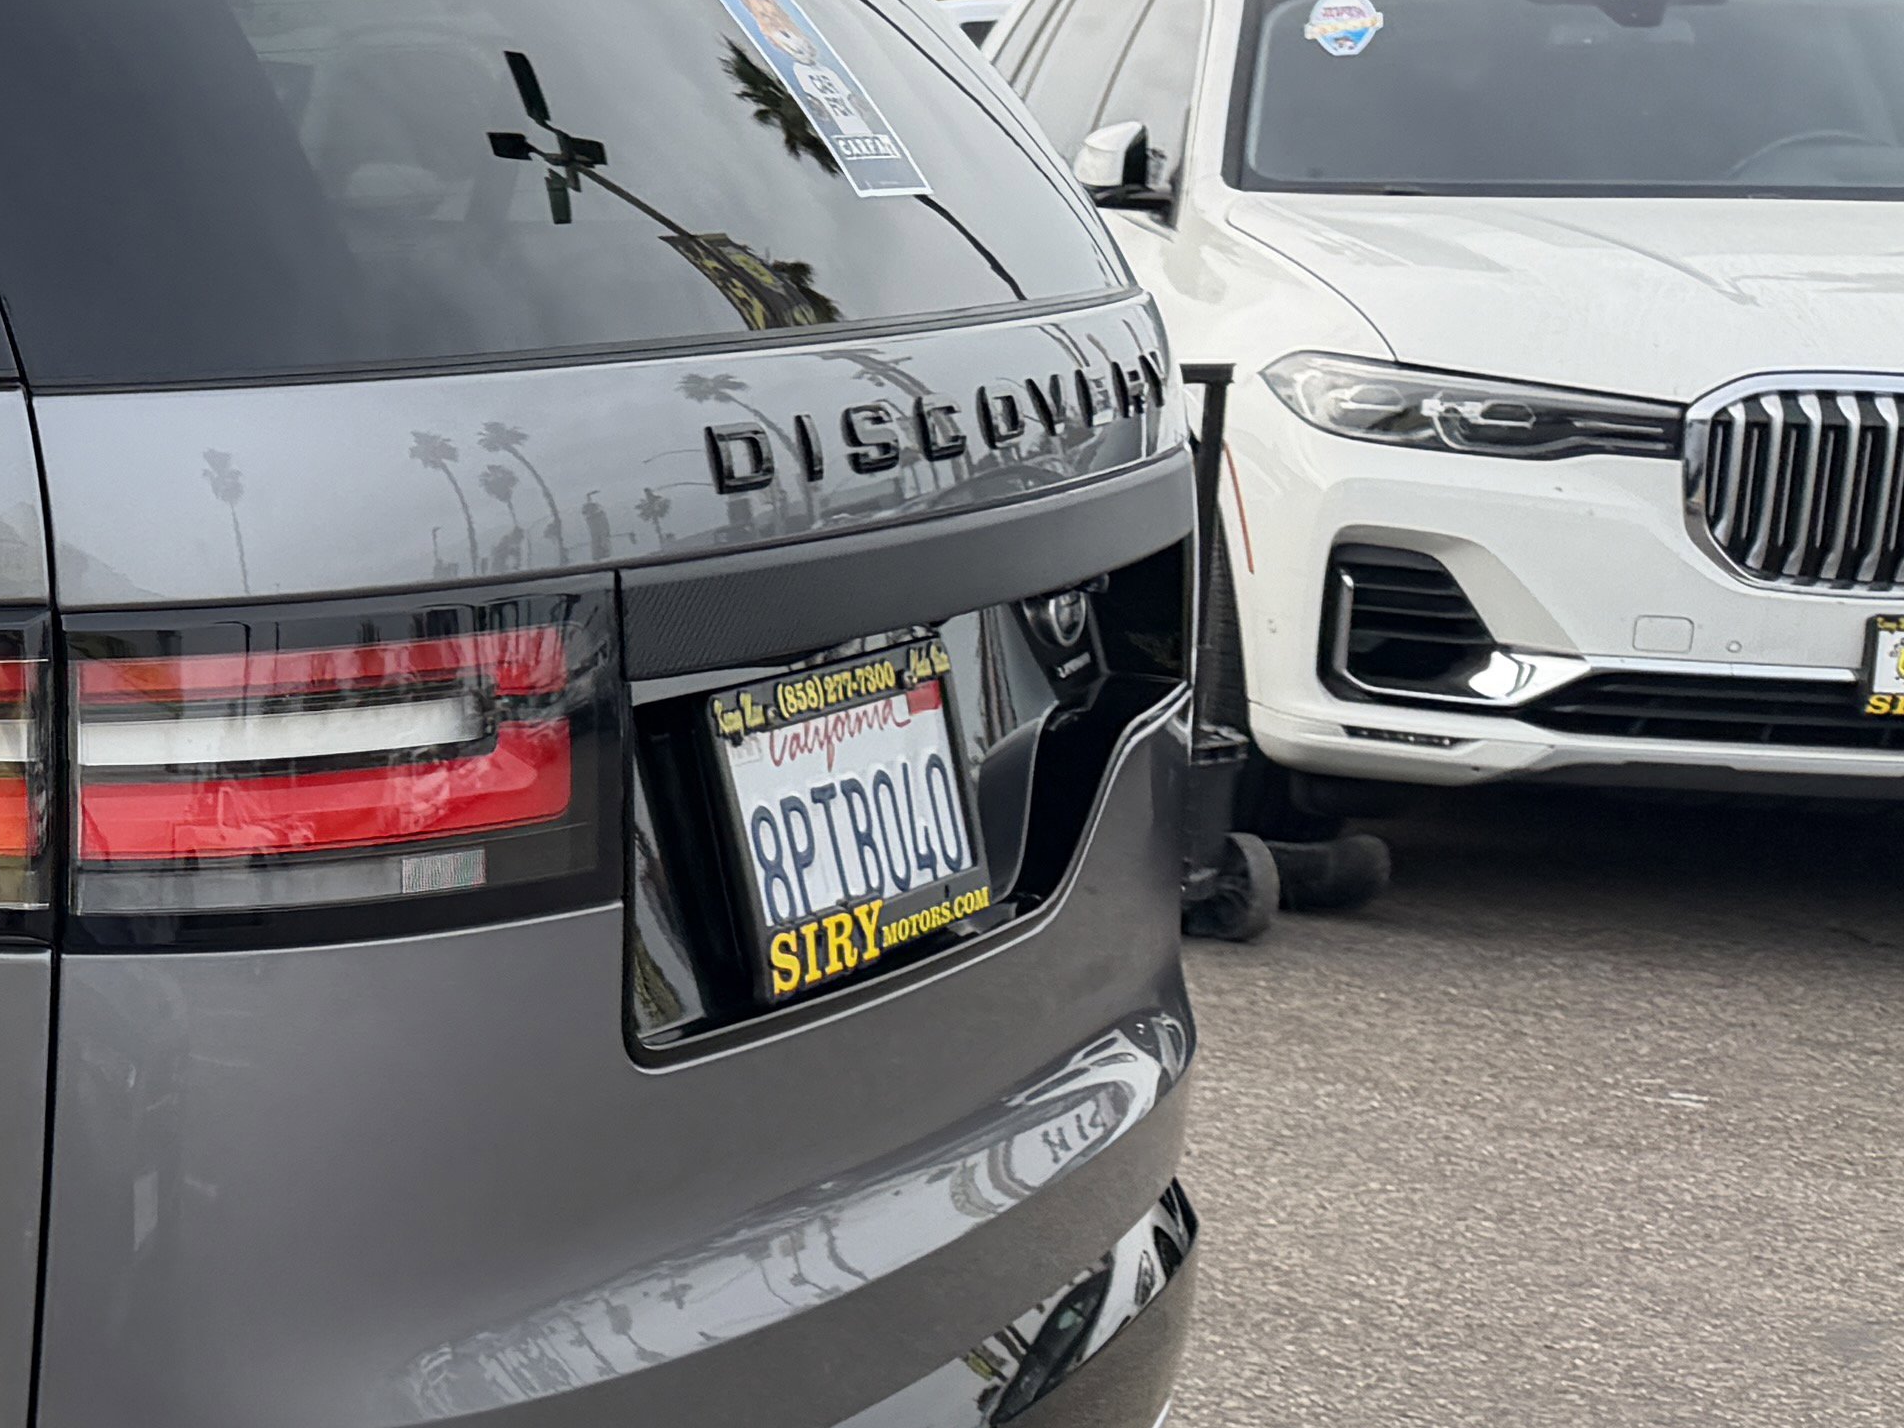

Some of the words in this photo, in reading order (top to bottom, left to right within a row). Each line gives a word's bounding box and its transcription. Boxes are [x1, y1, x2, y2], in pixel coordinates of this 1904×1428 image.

[705, 350, 1167, 495] DISCOVERY
[769, 697, 912, 772] California
[751, 754, 964, 925] 8PTB040
[769, 899, 885, 995] SIRY
